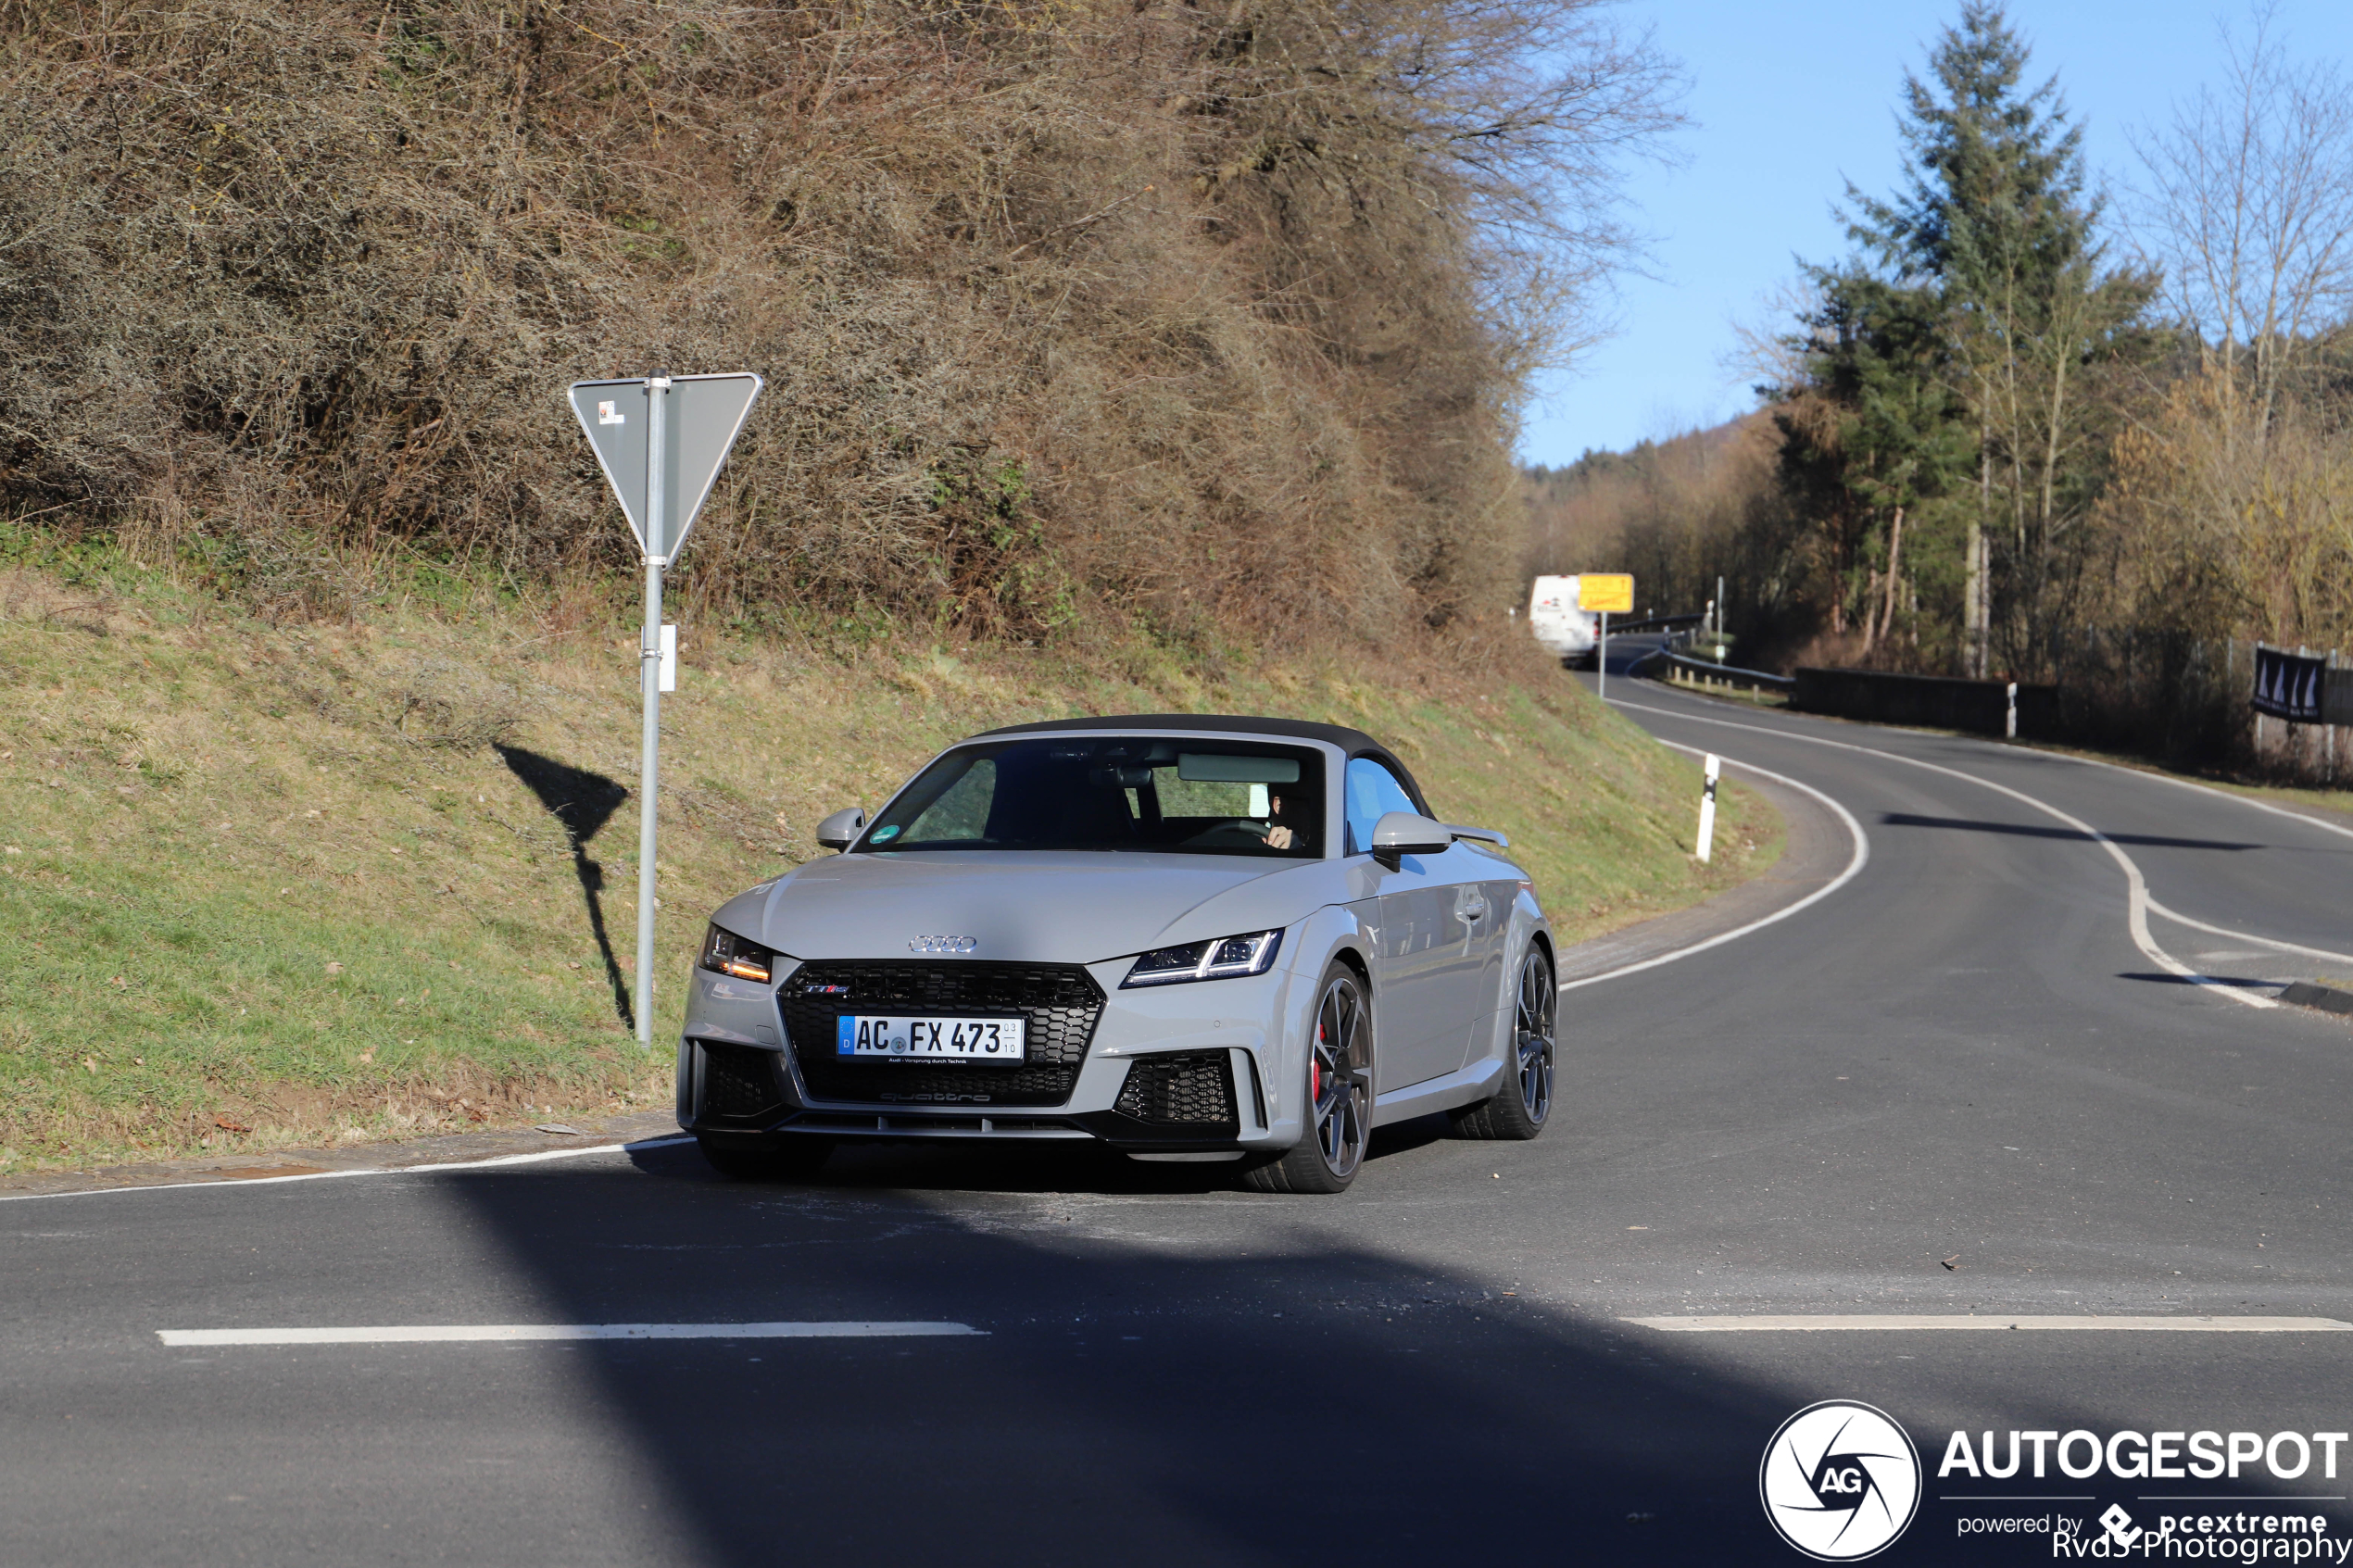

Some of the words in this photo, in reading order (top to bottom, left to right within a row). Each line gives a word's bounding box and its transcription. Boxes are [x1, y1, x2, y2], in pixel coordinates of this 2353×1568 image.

[1003, 1022, 1016, 1032] 03
[856, 1020, 889, 1050] AC
[910, 1022, 943, 1052] FX
[950, 1022, 1000, 1053] 473
[843, 1039, 850, 1048] D
[1004, 1044, 1016, 1053] 10
[880, 1093, 991, 1102] quattro
